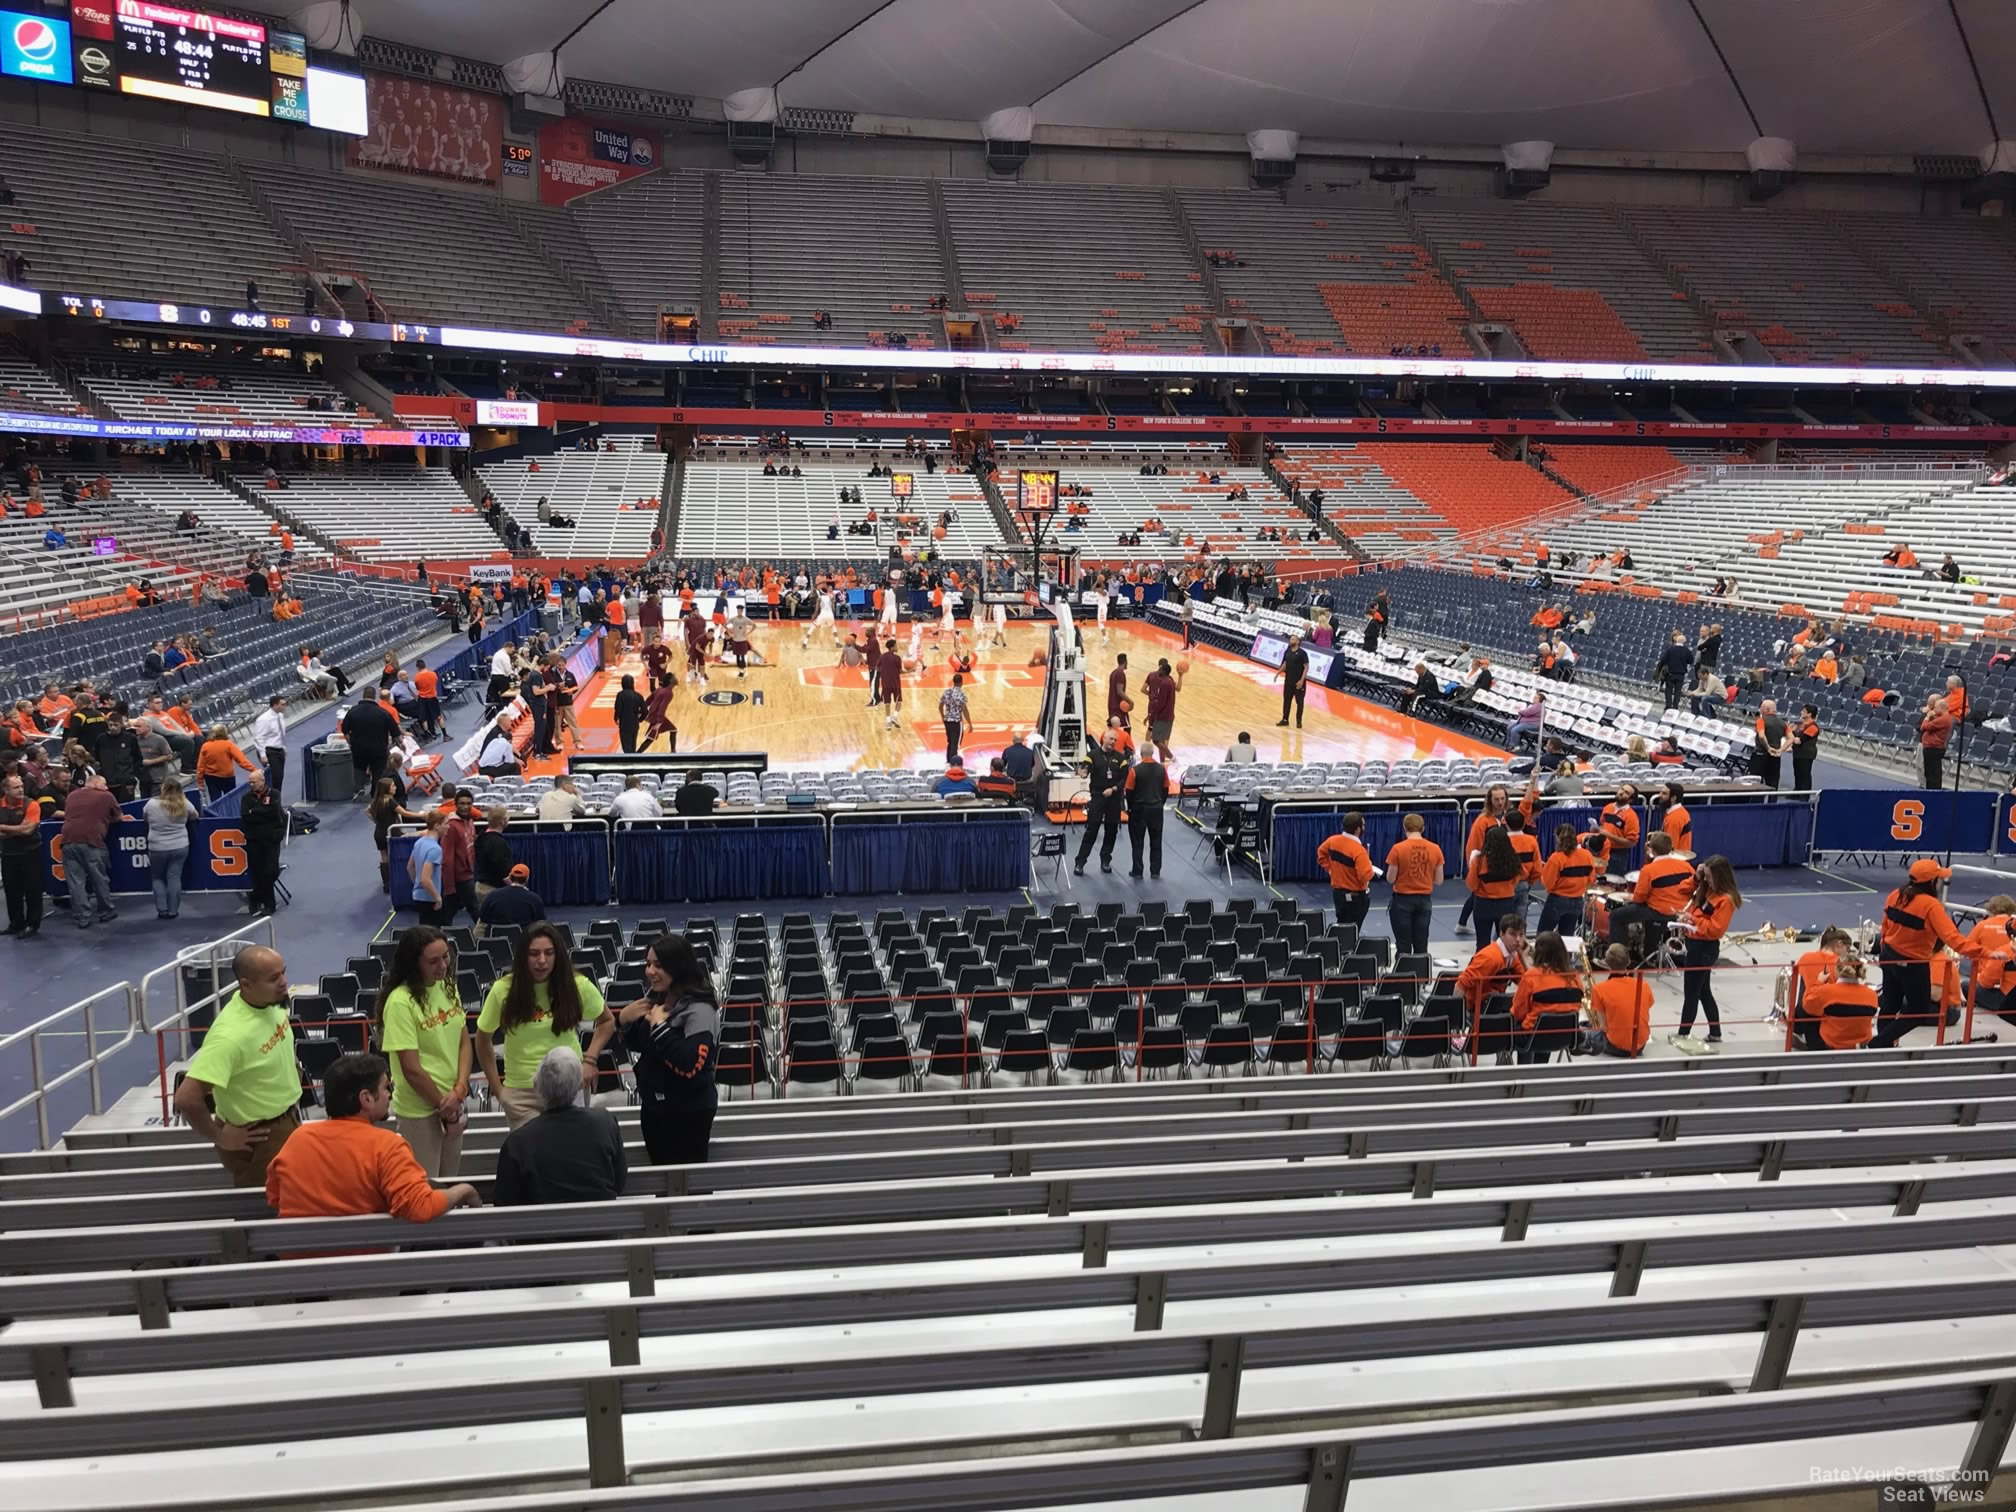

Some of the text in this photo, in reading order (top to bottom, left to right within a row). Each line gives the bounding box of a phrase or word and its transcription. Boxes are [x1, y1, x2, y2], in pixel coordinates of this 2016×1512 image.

[174, 40, 213, 58] 48:44
[277, 78, 301, 90] TAKE
[283, 87, 297, 99] ME
[283, 97, 297, 108] TO
[274, 105, 308, 120] CROUSE
[595, 131, 628, 148] United
[608, 145, 628, 163] Way
[551, 159, 620, 177] SYRACUSE UNIVERSITY
[558, 167, 580, 178] PROUD
[580, 170, 617, 183] SUPPORTER
[562, 174, 574, 183] THE
[69, 306, 78, 316] 4
[95, 308, 103, 317] 0
[200, 310, 211, 324] 0
[231, 313, 267, 328] 48:45
[271, 318, 291, 329] 1ST
[311, 320, 321, 333] 0
[460, 402, 471, 413] 112
[500, 413, 528, 421] DONUTS
[672, 413, 684, 422] 113
[964, 418, 976, 428] 114
[1143, 417, 1154, 425] NEW
[1172, 417, 1192, 425] COLLEGE
[1192, 417, 1206, 425] TEAM
[105, 425, 153, 435] PURCHASE
[155, 427, 185, 436] TODAY
[186, 428, 198, 436] AT
[199, 428, 223, 437] YOUR
[224, 429, 252, 438] LOCAL
[252, 429, 293, 439] FASTRAC!
[1242, 421, 1252, 431] 115
[417, 433, 427, 444] 4
[430, 432, 462, 446] PACK
[1022, 472, 1056, 485] 48:44
[1028, 486, 1050, 507] 30
[473, 569, 512, 579] KeyBank
[1891, 799, 1926, 841] S
[118, 836, 147, 850] 108
[209, 828, 248, 877] S
